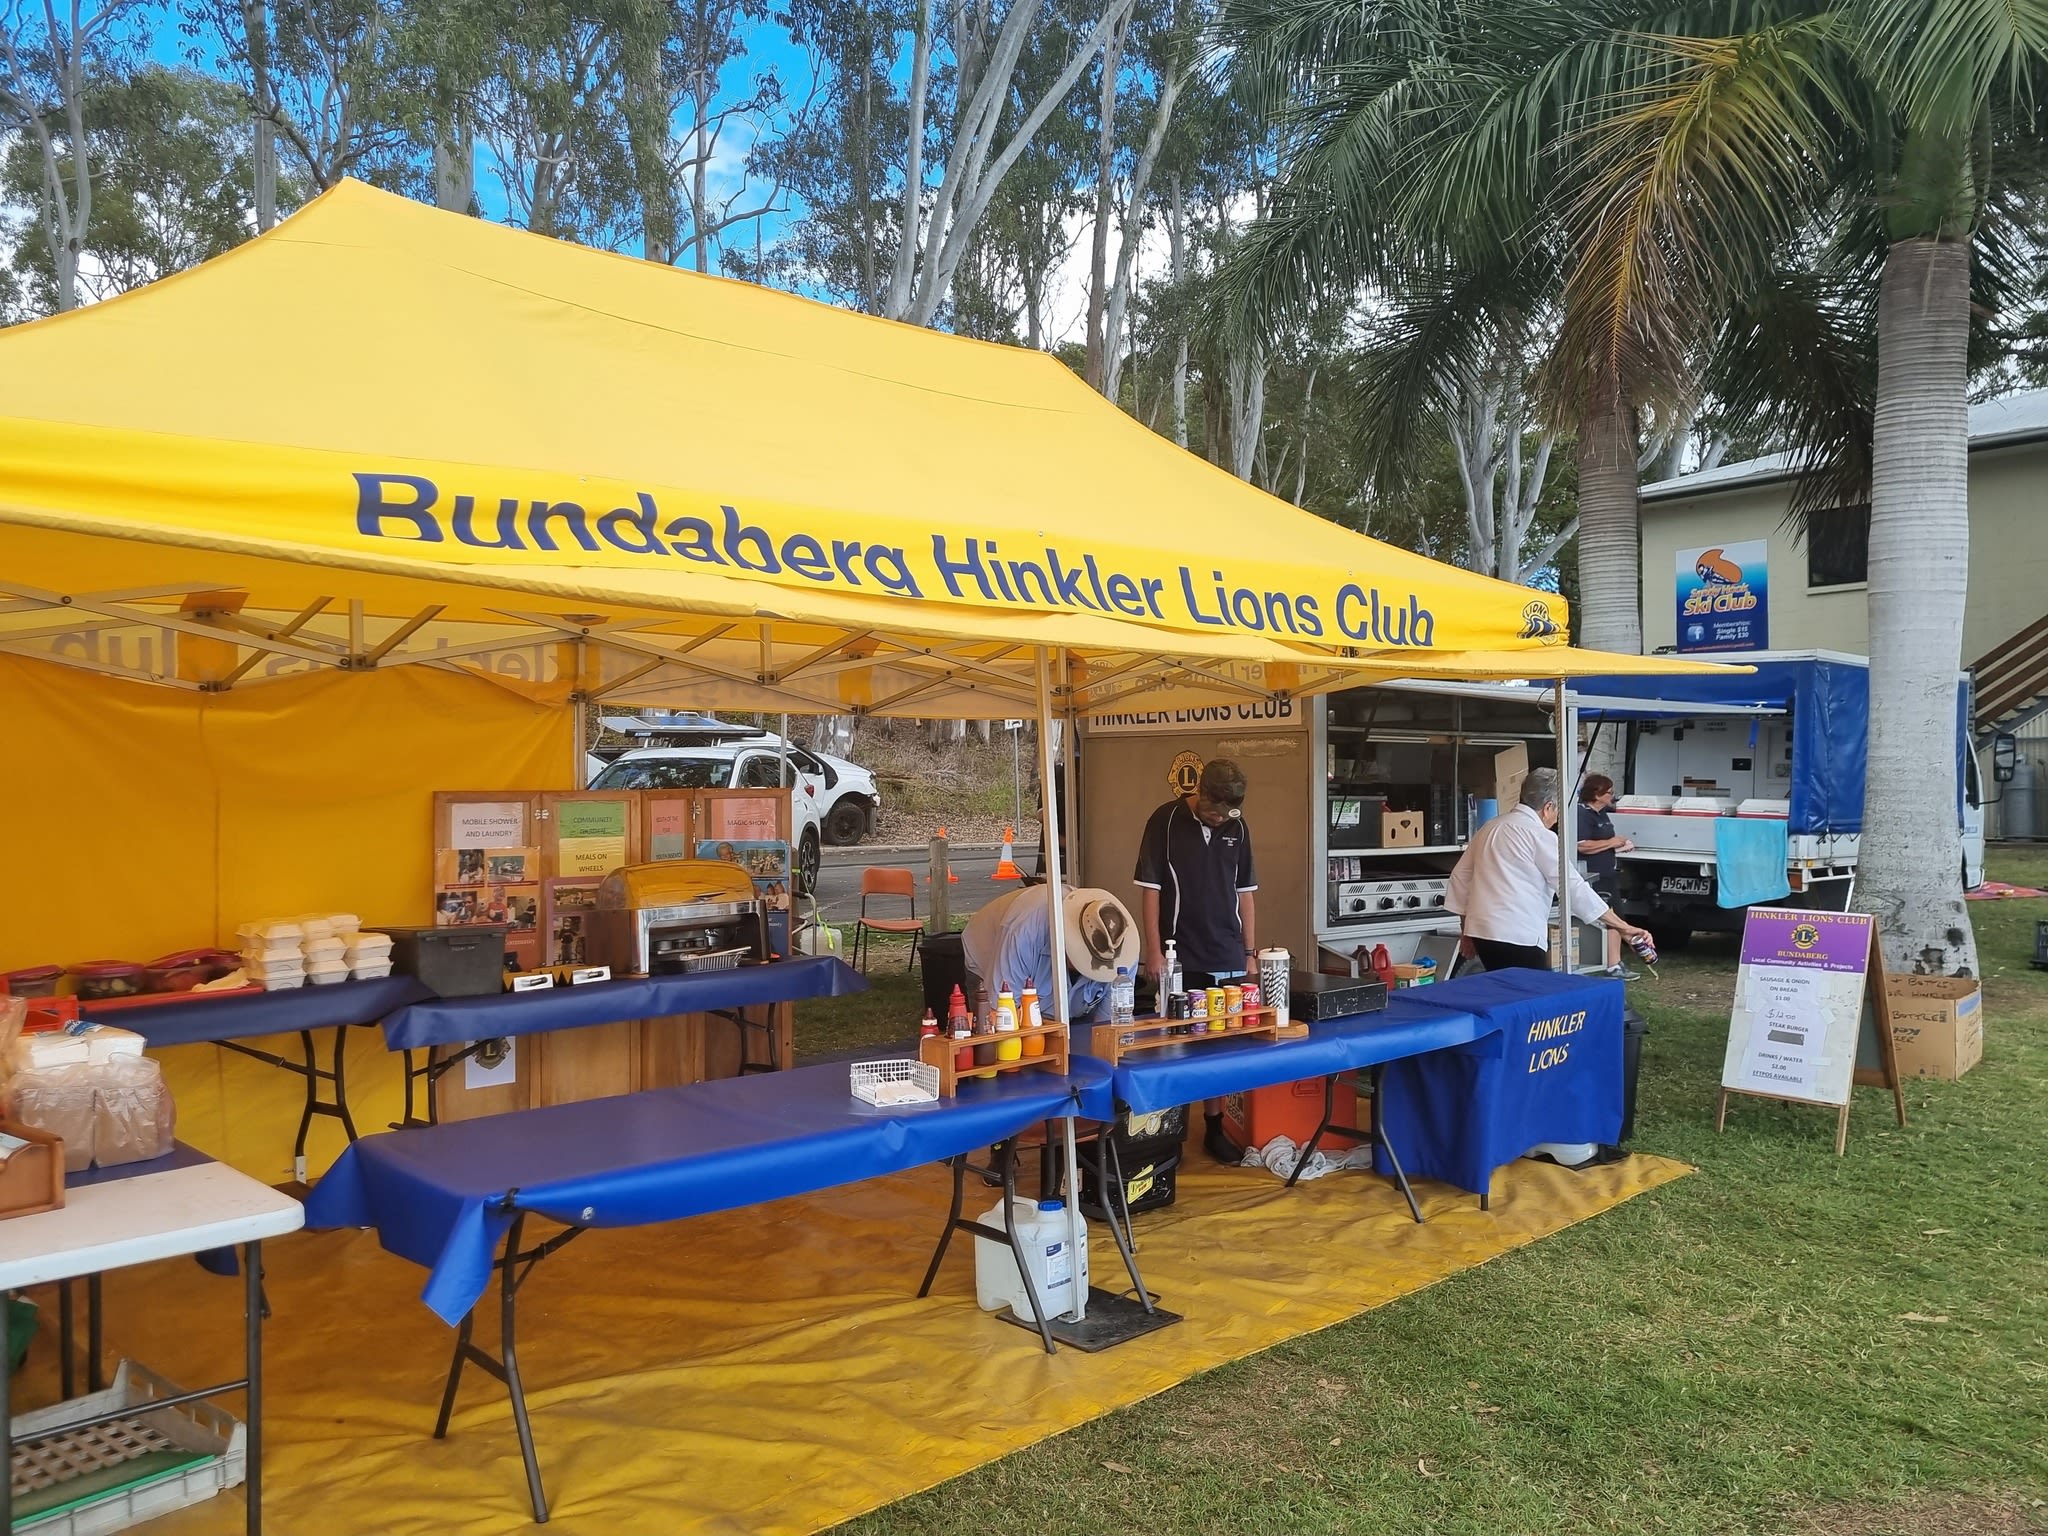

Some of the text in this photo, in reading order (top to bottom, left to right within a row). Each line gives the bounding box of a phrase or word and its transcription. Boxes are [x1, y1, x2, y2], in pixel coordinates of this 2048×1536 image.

[352, 472, 1434, 647] Bundaberg Hinkler Lions Club
[1683, 592, 1757, 616] Ski Club
[1526, 603, 1547, 619] LIONS
[1176, 705, 1231, 722] LIONS
[1238, 697, 1293, 719] CLUB
[489, 817, 518, 825] SHOWER
[482, 830, 513, 838] LAUNDRY
[578, 865, 604, 873] WHEELS
[1751, 911, 1868, 925] HINKLER LIONS CLUB
[1777, 950, 1828, 960] BUNDABERG
[1766, 959, 1796, 967] Community
[1527, 1010, 1586, 1044] HINKLER
[1786, 1024, 1809, 1033] BURGER
[1528, 1042, 1570, 1074] LIONS
[1758, 1051, 1779, 1059] DRINKS
[1752, 1070, 1803, 1083] EFTPOS AVAILABLE
